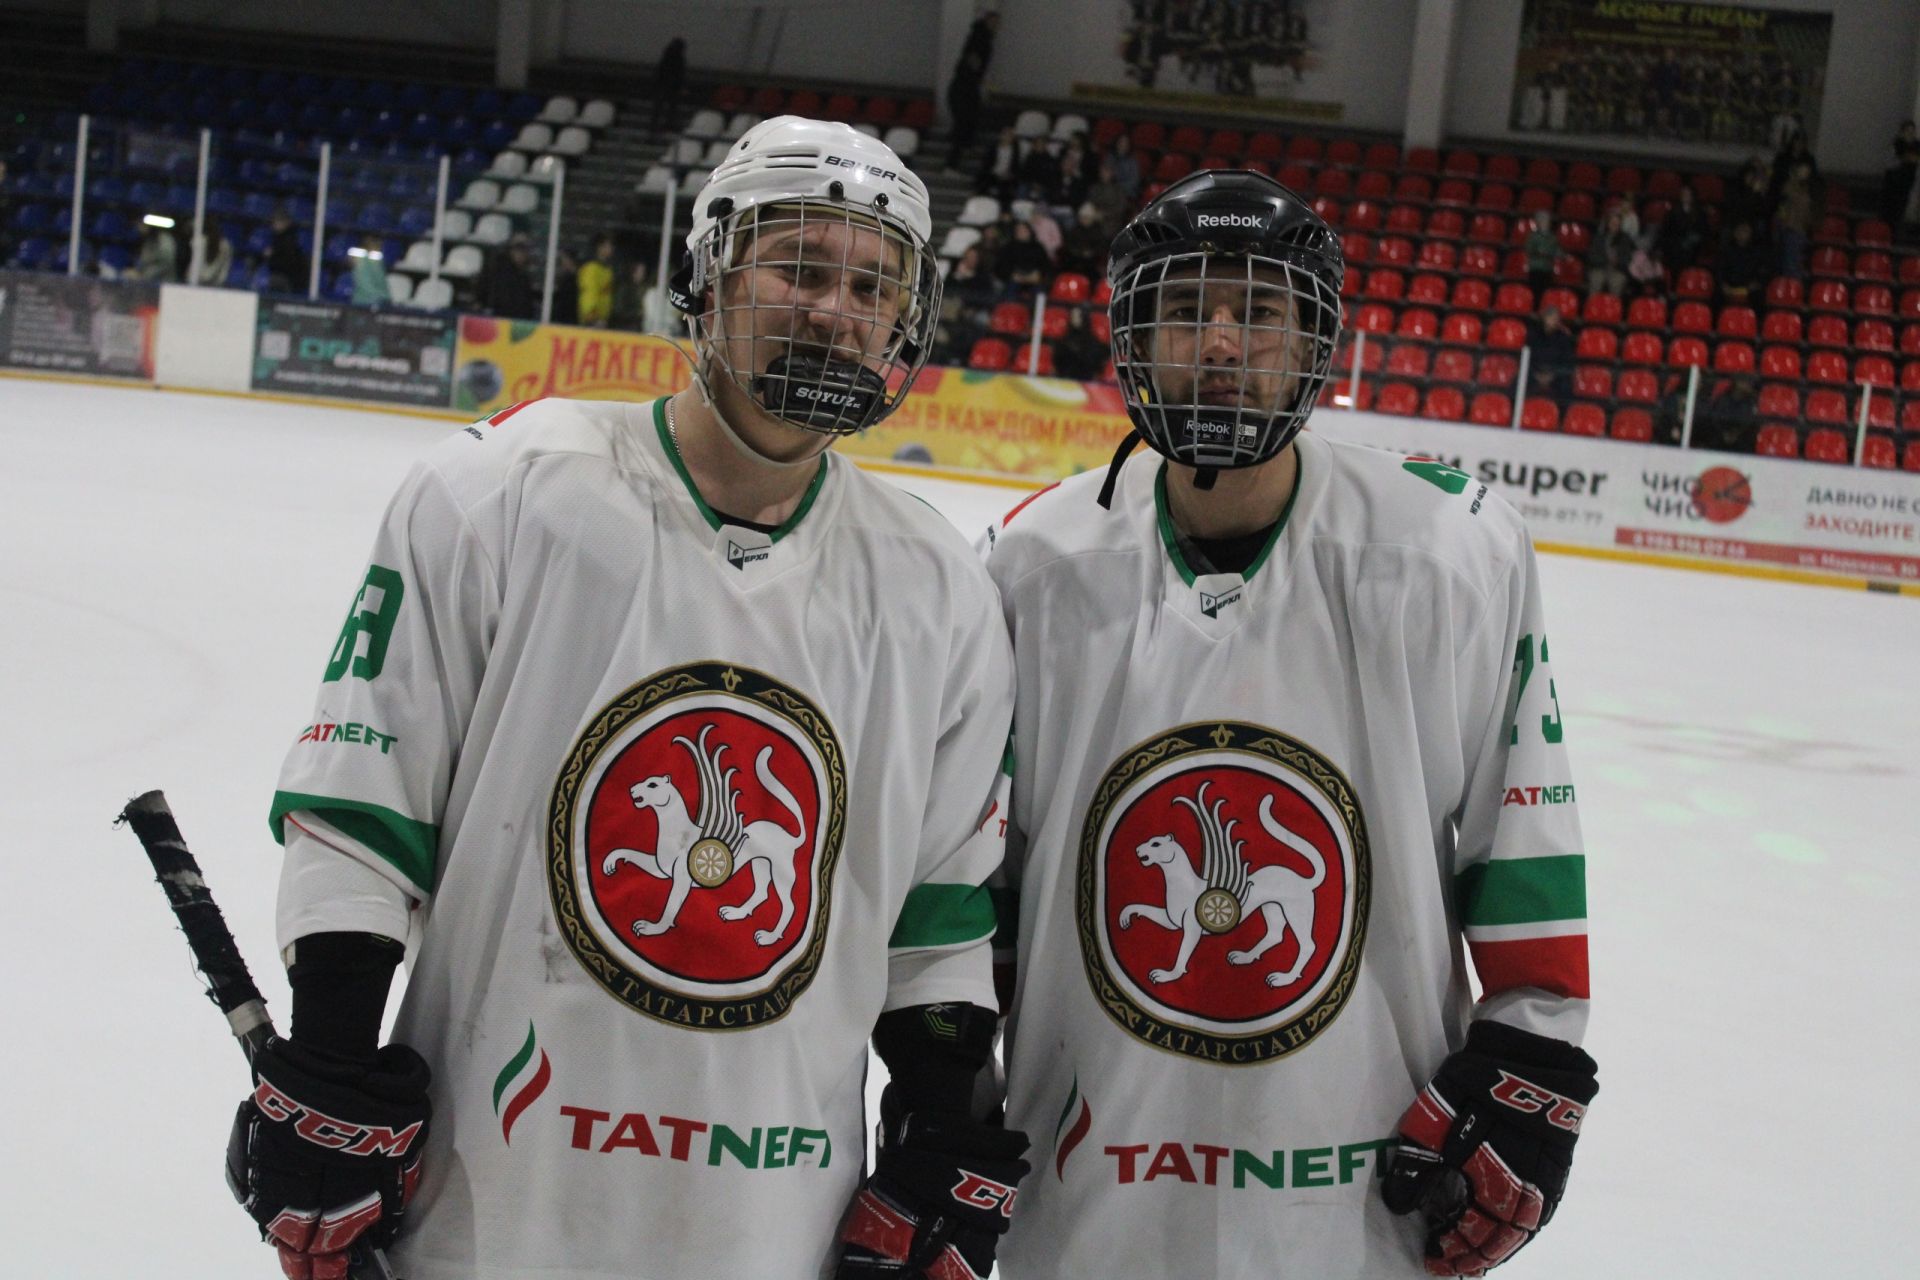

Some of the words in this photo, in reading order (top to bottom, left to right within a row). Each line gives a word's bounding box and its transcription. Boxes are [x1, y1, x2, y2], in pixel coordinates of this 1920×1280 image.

[1197, 213, 1263, 229] Reebok
[795, 387, 856, 407] SOYUZ
[1185, 419, 1231, 434] Reebok
[1478, 458, 1609, 498] super
[1806, 486, 1877, 509] ДАВНО
[1882, 494, 1907, 513] НЕ
[1805, 512, 1915, 541] ЗАХОДИТЕ
[1142, 1021, 1307, 1060] ТАТАРСТАН
[255, 1072, 424, 1158] CCM
